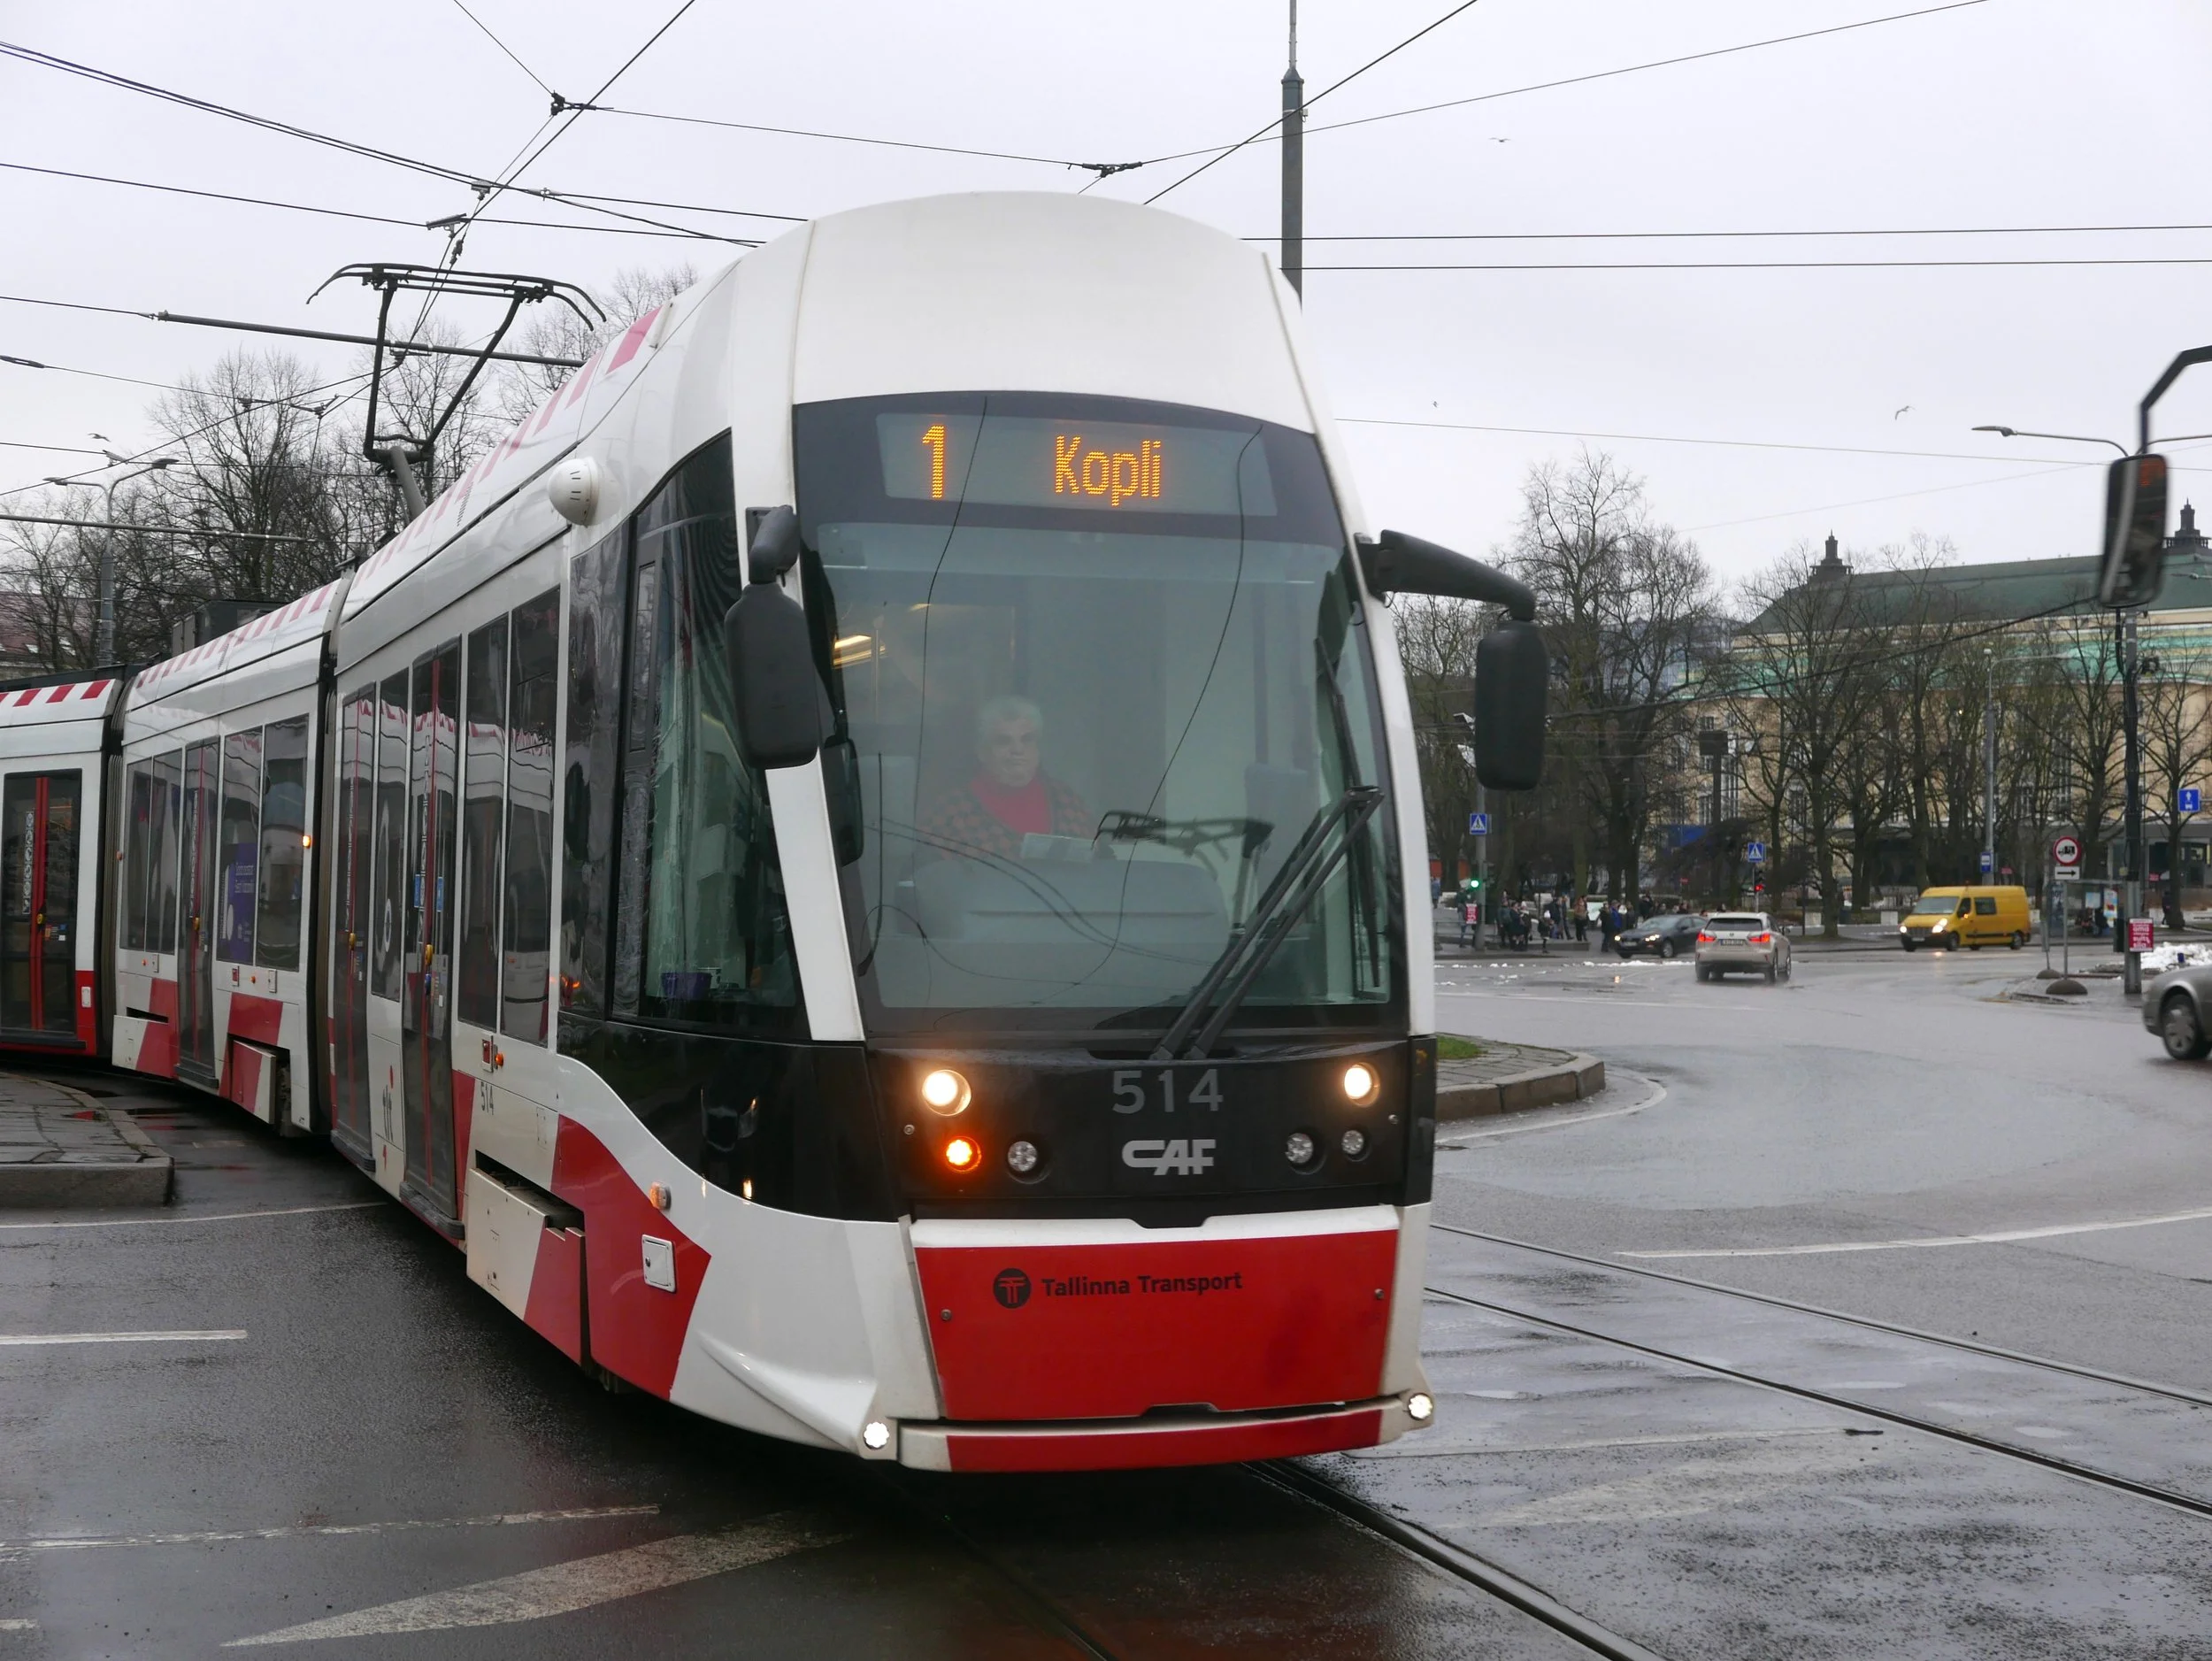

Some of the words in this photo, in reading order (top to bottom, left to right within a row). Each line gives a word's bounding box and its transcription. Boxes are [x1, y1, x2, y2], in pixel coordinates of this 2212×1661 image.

[922, 425, 944, 498] 1
[1055, 435, 1161, 507] Kopli
[1112, 1069, 1224, 1114] 514
[1121, 1139, 1217, 1176] CAF
[1041, 1277, 1131, 1296] Tallinna
[1137, 1273, 1243, 1296] Transport
